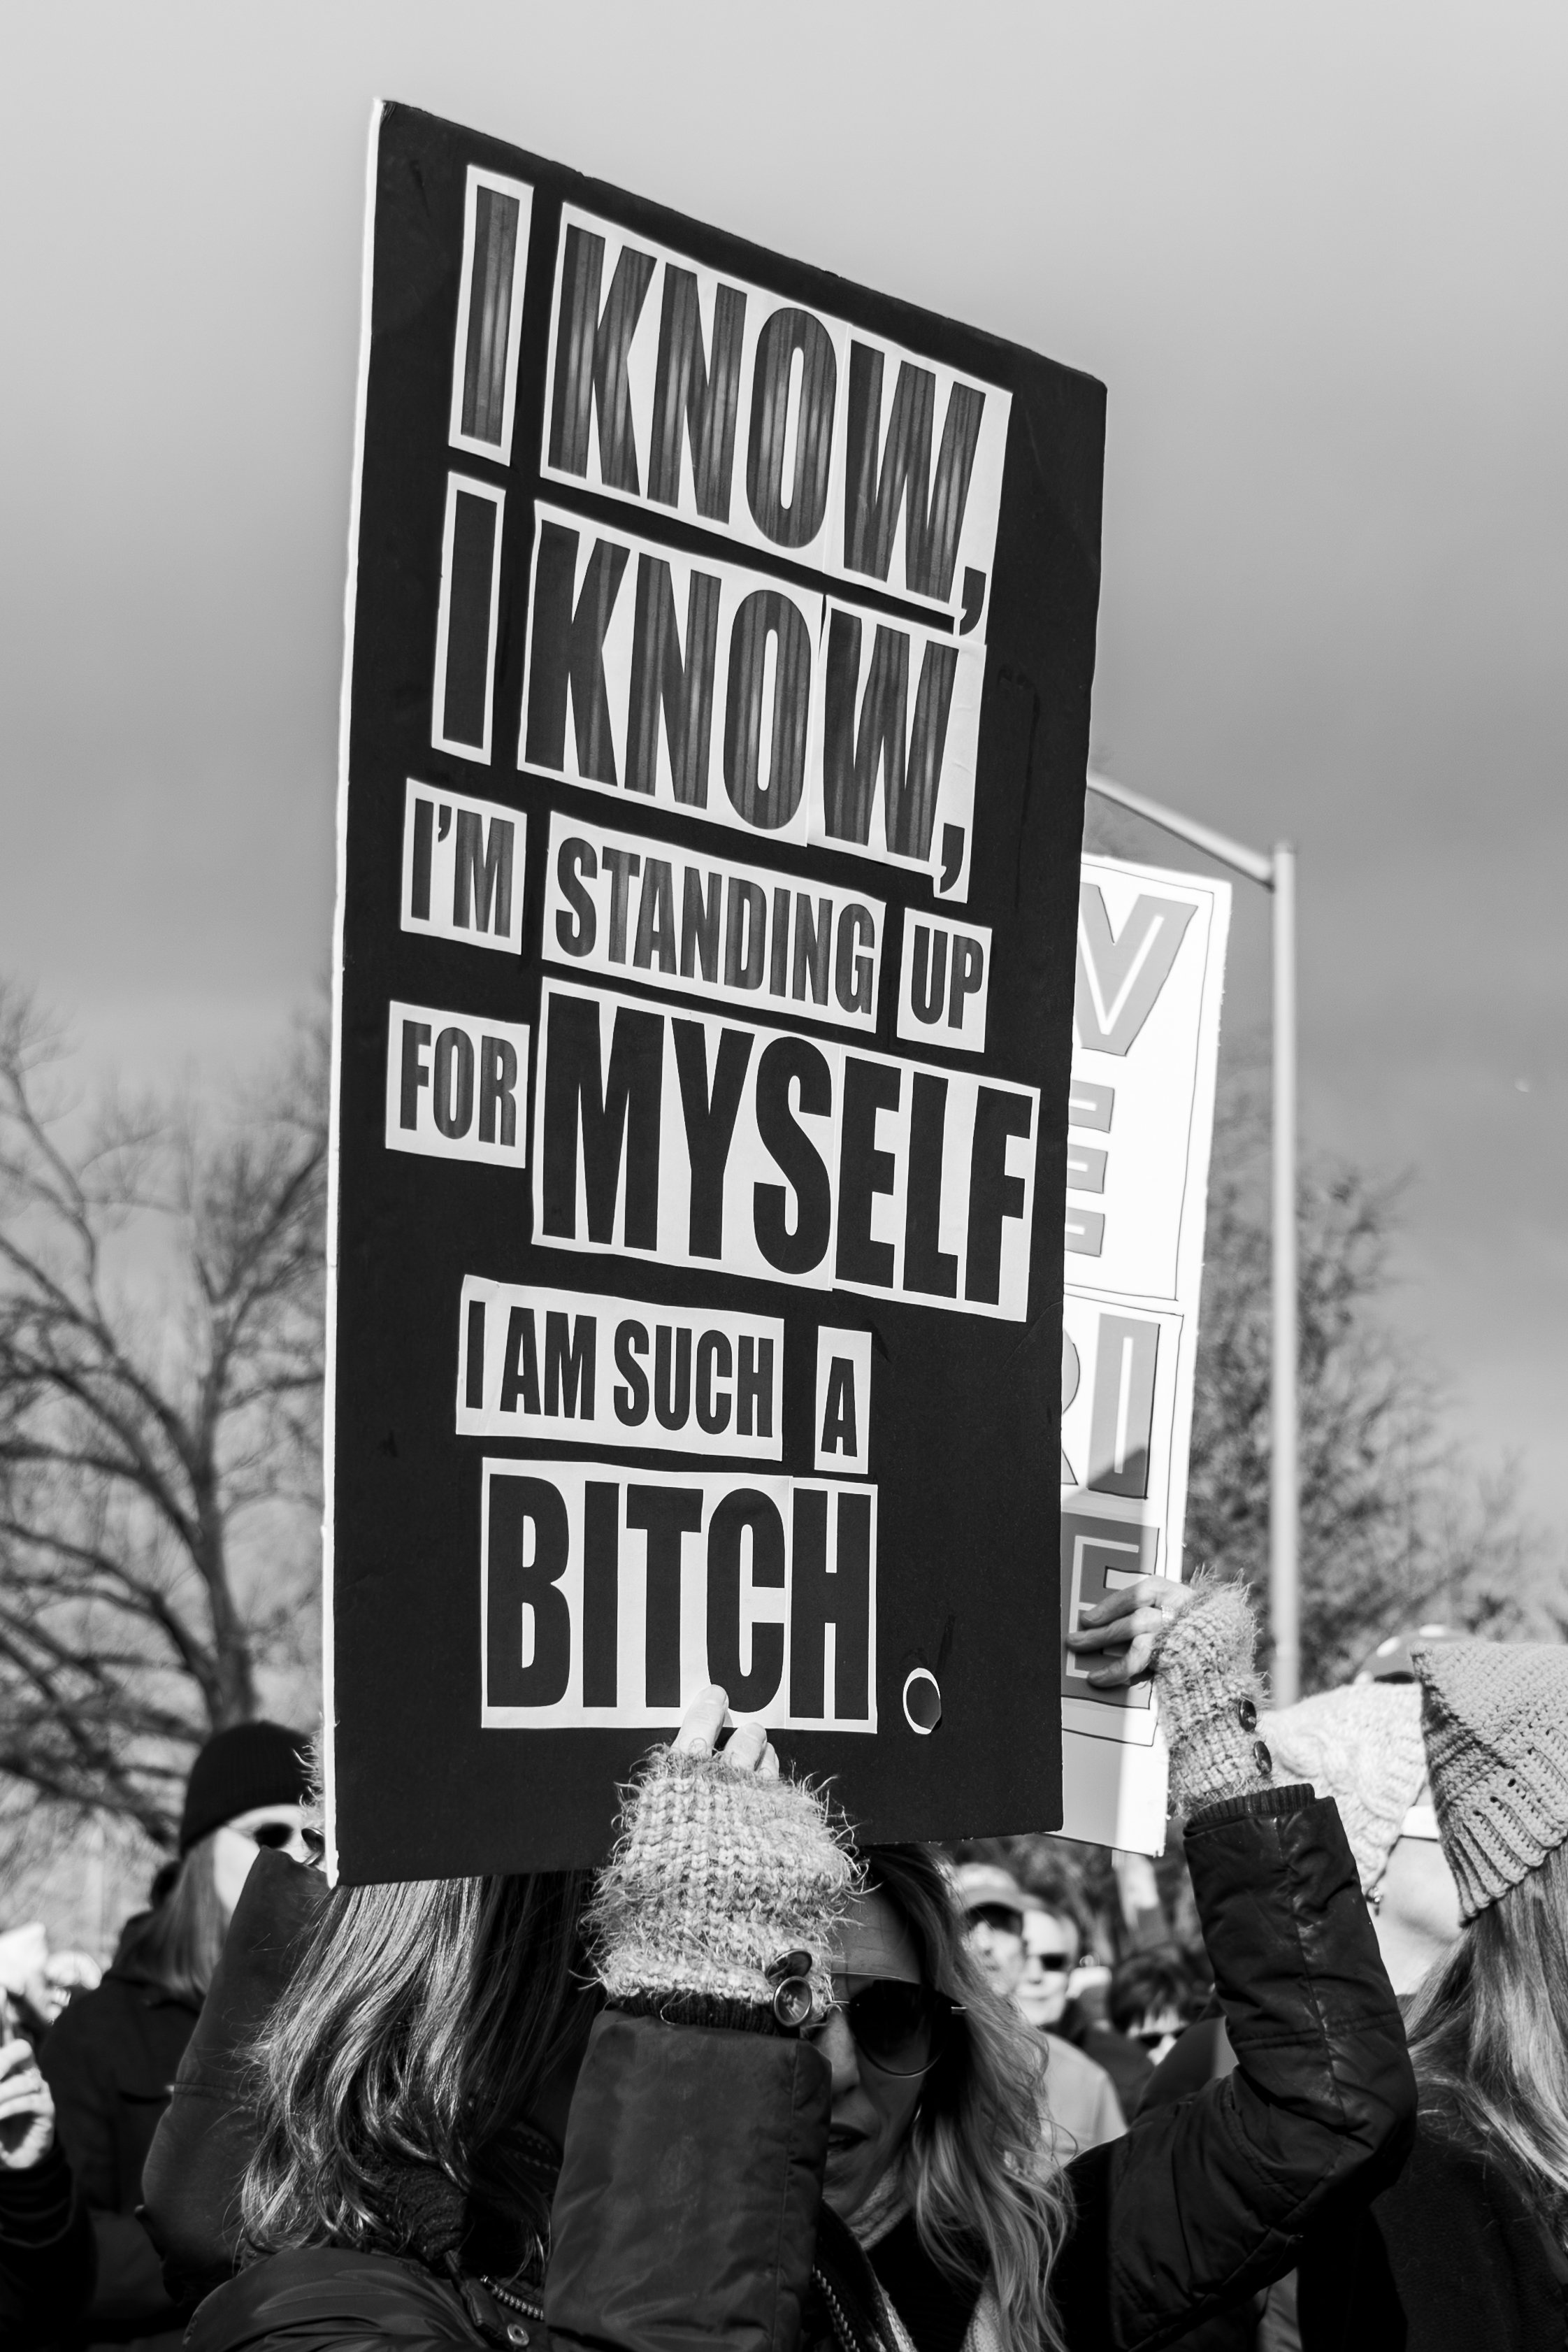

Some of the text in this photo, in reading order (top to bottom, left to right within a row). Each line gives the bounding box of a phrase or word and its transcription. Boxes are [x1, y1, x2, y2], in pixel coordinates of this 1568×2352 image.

[459, 185, 986, 636] I KNOW,
[443, 489, 965, 894] I KNOW,
[411, 798, 984, 1030] I'M STANDING UP
[399, 1020, 517, 1147] FOR
[541, 991, 1033, 1305] MYSELF
[466, 1300, 858, 1457] I AM SUCH A
